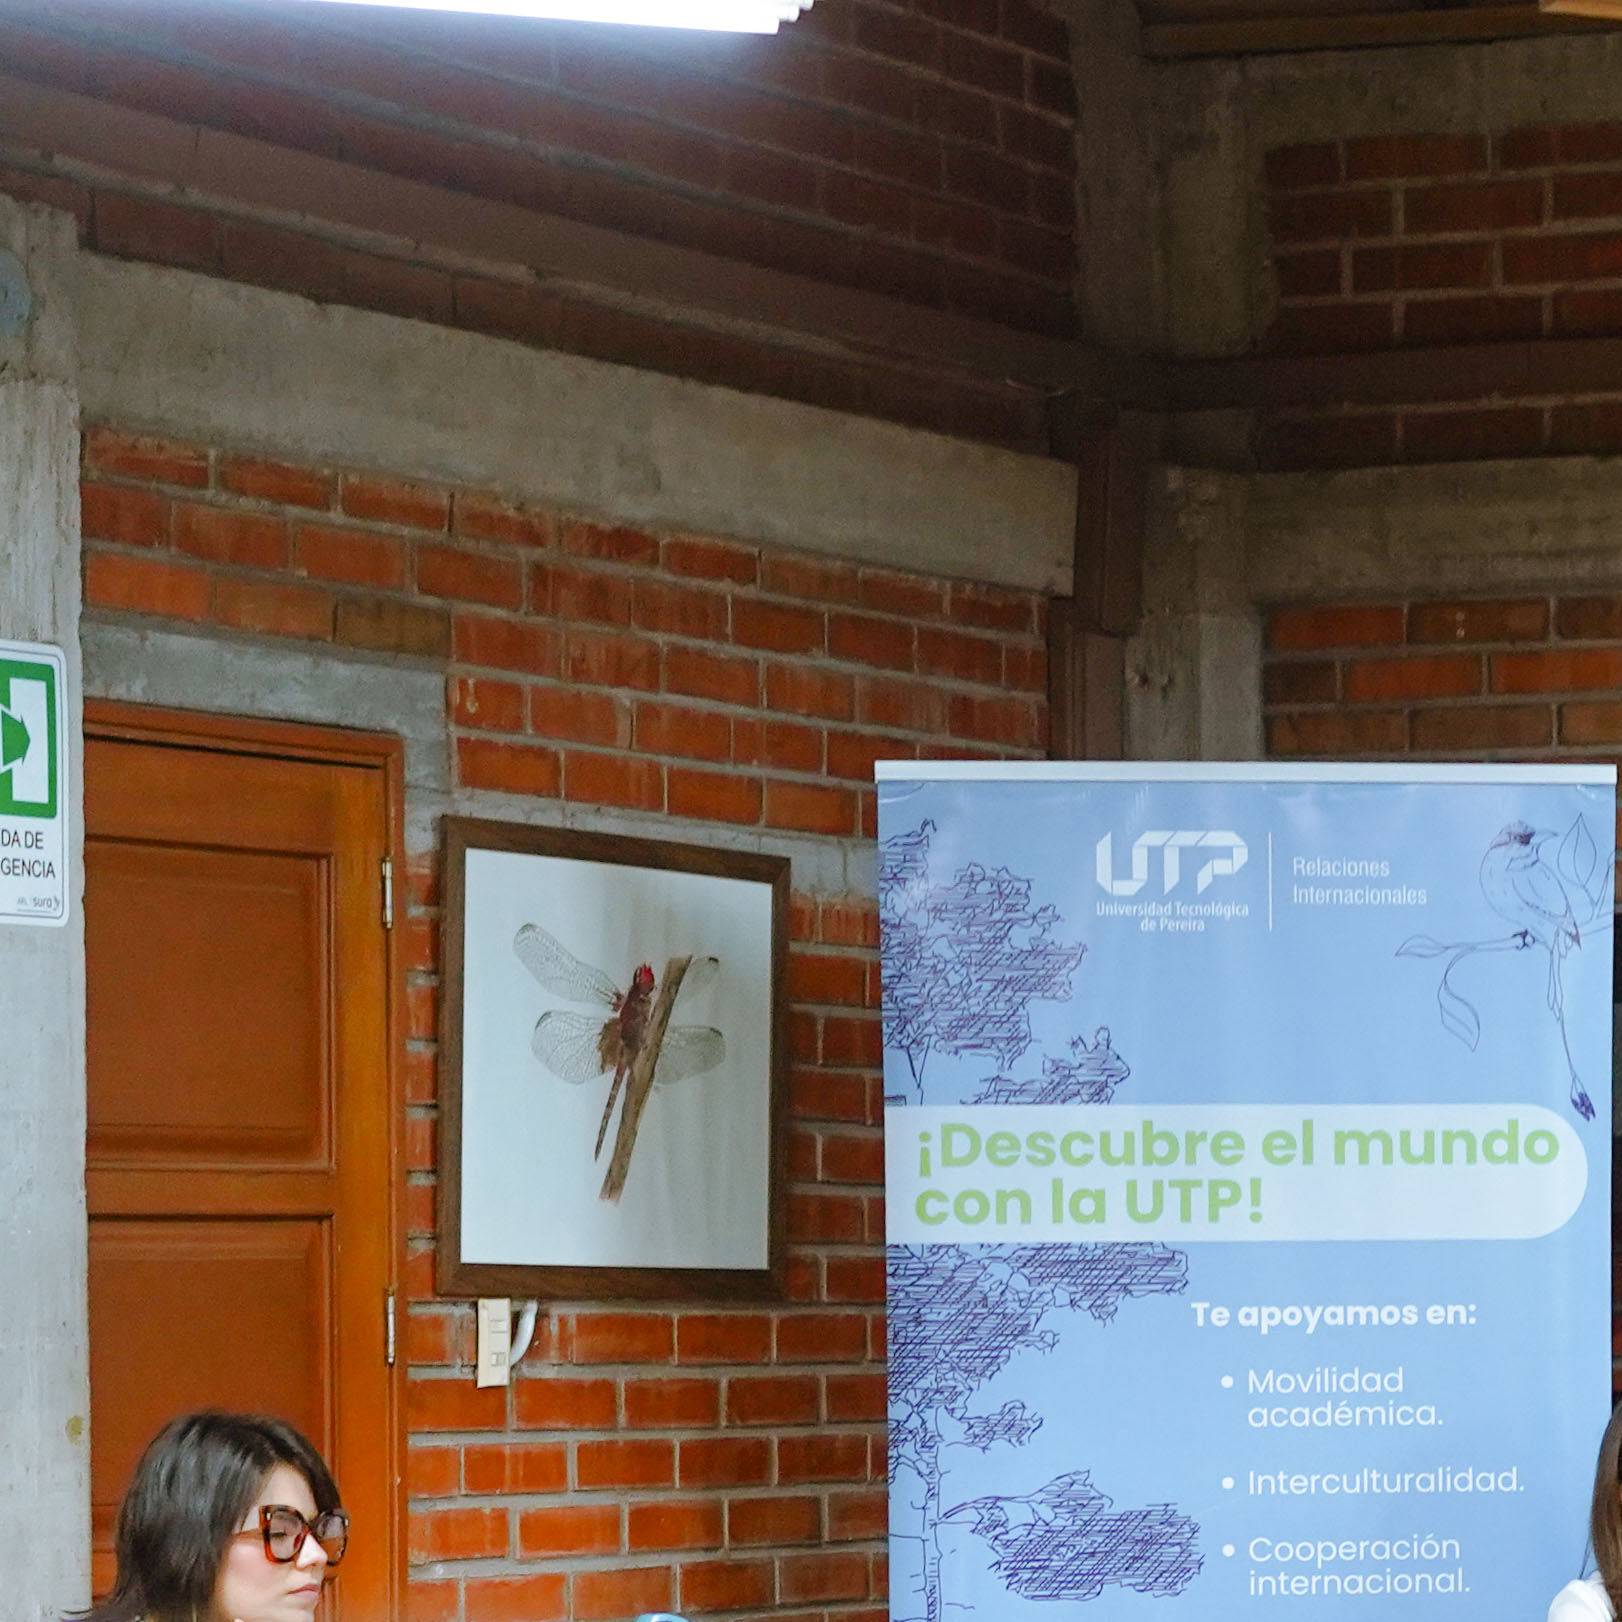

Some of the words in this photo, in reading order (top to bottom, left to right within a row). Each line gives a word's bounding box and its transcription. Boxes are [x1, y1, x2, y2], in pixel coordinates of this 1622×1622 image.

[25, 831, 44, 850] DE
[1096, 830, 1248, 896] UTP
[1293, 856, 1390, 878] Relaciones
[1293, 884, 1428, 905] Internacionales
[1096, 902, 1171, 917] Universidad
[1175, 901, 1249, 920] Tecnológica
[1140, 918, 1157, 932] de
[1160, 918, 1205, 932] Pereira
[917, 1119, 1246, 1177] ¡Descubre
[1262, 1119, 1314, 1167] el
[1334, 1119, 1560, 1166] mundo
[915, 1188, 1032, 1226] con
[1051, 1178, 1107, 1225] la
[1126, 1178, 1263, 1225] UTP!
[1191, 1302, 1232, 1328] Te
[1238, 1304, 1419, 1335] apoyamos
[1426, 1303, 1477, 1326] en:
[1248, 1366, 1405, 1395] Movilidad
[1248, 1400, 1444, 1429] académica.
[1249, 1466, 1525, 1496] Interculturalidad.
[1248, 1533, 1461, 1571] Cooperación
[1249, 1568, 1471, 1597] internacional.
